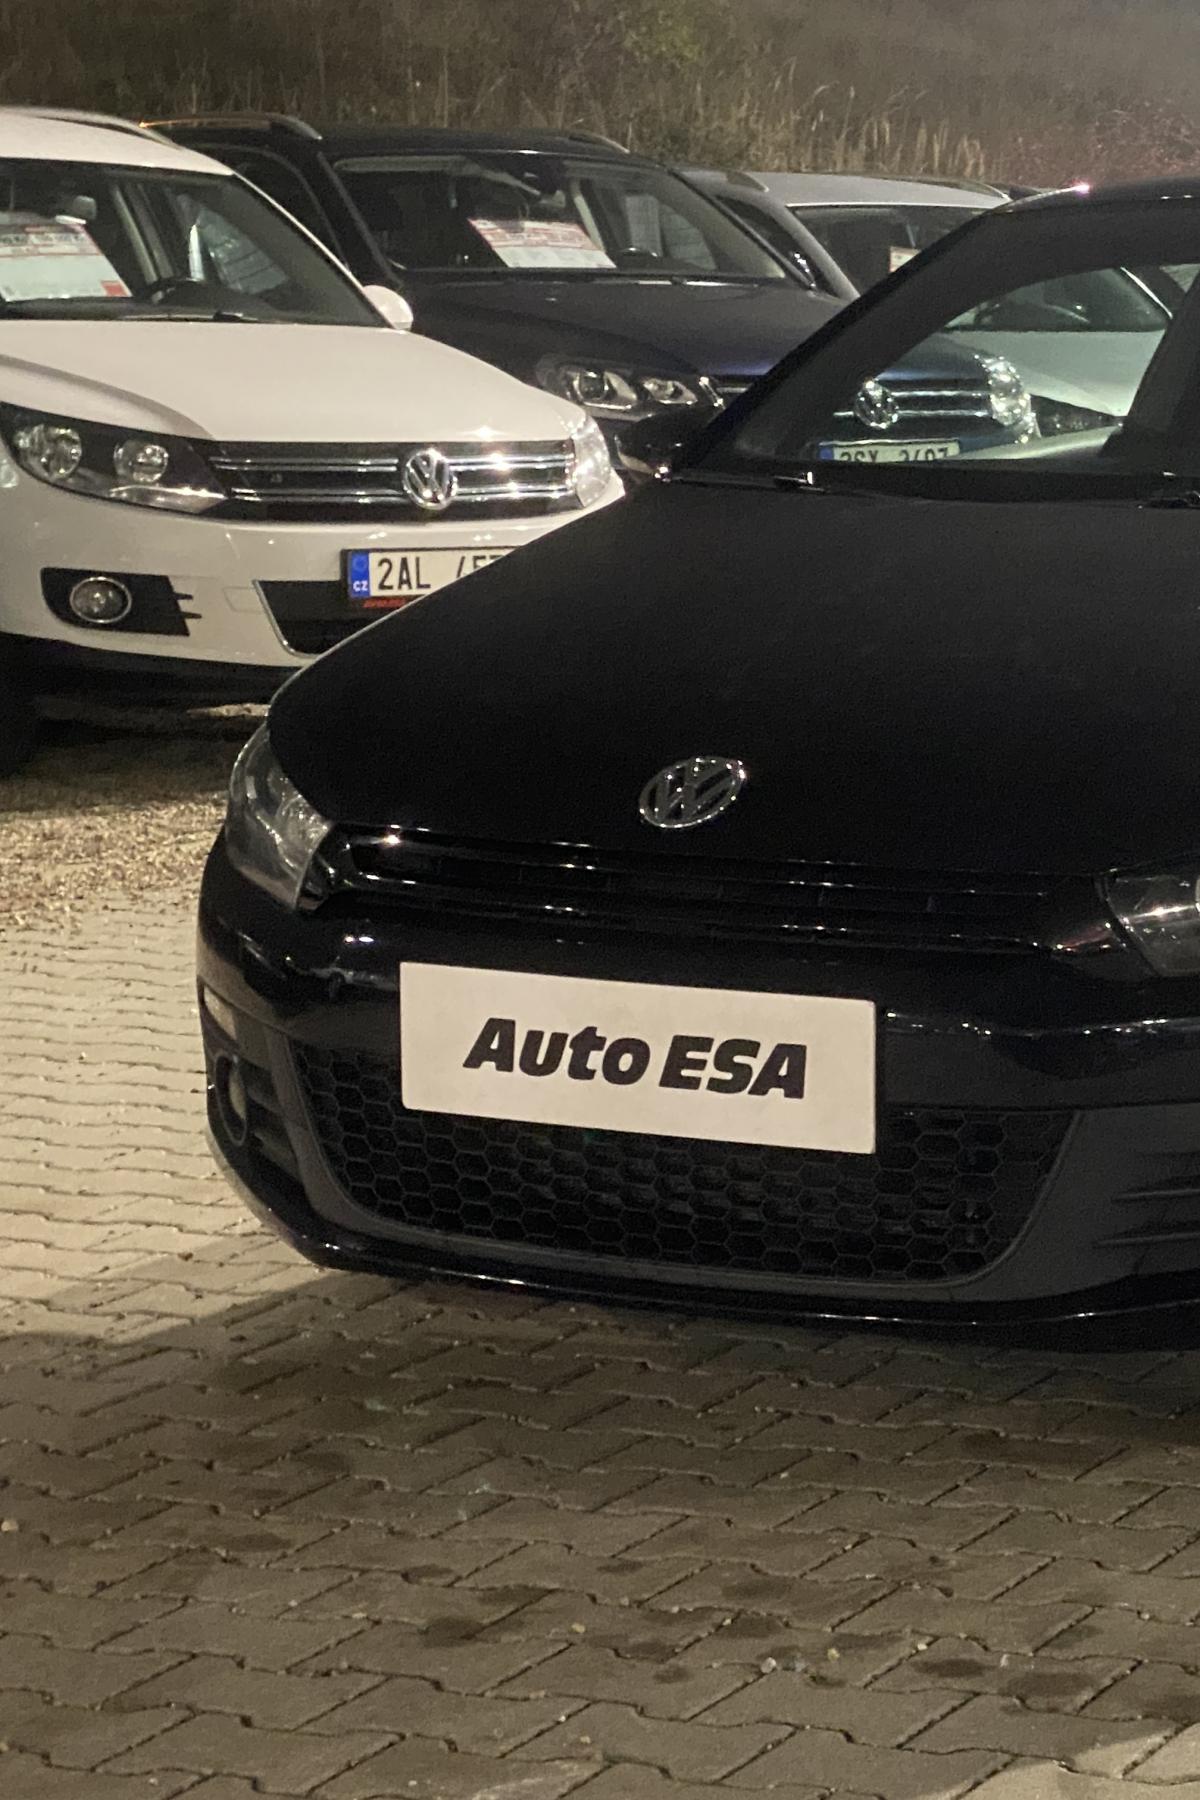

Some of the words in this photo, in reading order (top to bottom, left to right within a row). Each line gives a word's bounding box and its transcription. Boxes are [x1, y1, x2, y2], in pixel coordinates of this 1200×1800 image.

[353, 581, 368, 592] CZ
[378, 557, 431, 590] 2AL
[639, 756, 744, 828] VW
[463, 1018, 650, 1085] Auto
[659, 1035, 806, 1099] ESA
